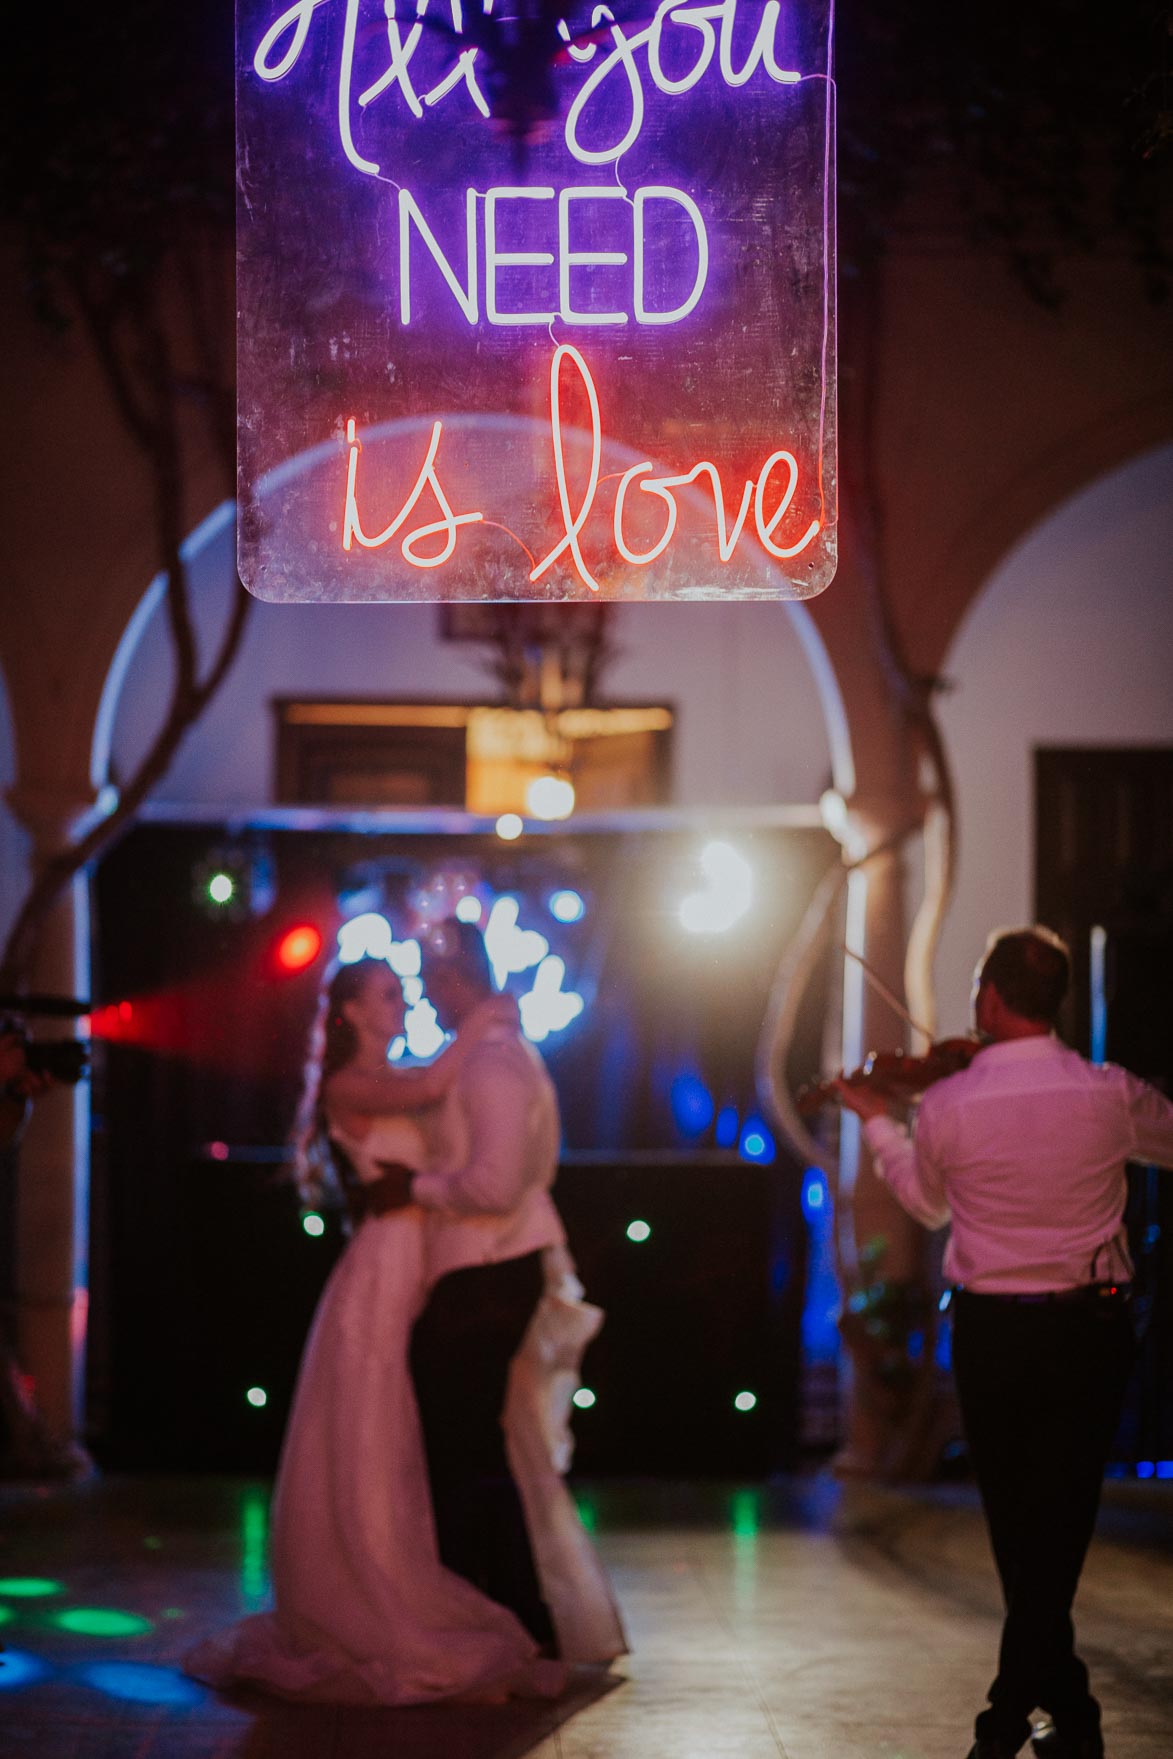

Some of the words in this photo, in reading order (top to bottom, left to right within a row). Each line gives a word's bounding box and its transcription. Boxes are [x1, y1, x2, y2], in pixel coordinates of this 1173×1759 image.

[557, 0, 801, 164] you
[399, 186, 708, 326] NEED
[342, 419, 483, 568] is
[529, 344, 820, 592] love
